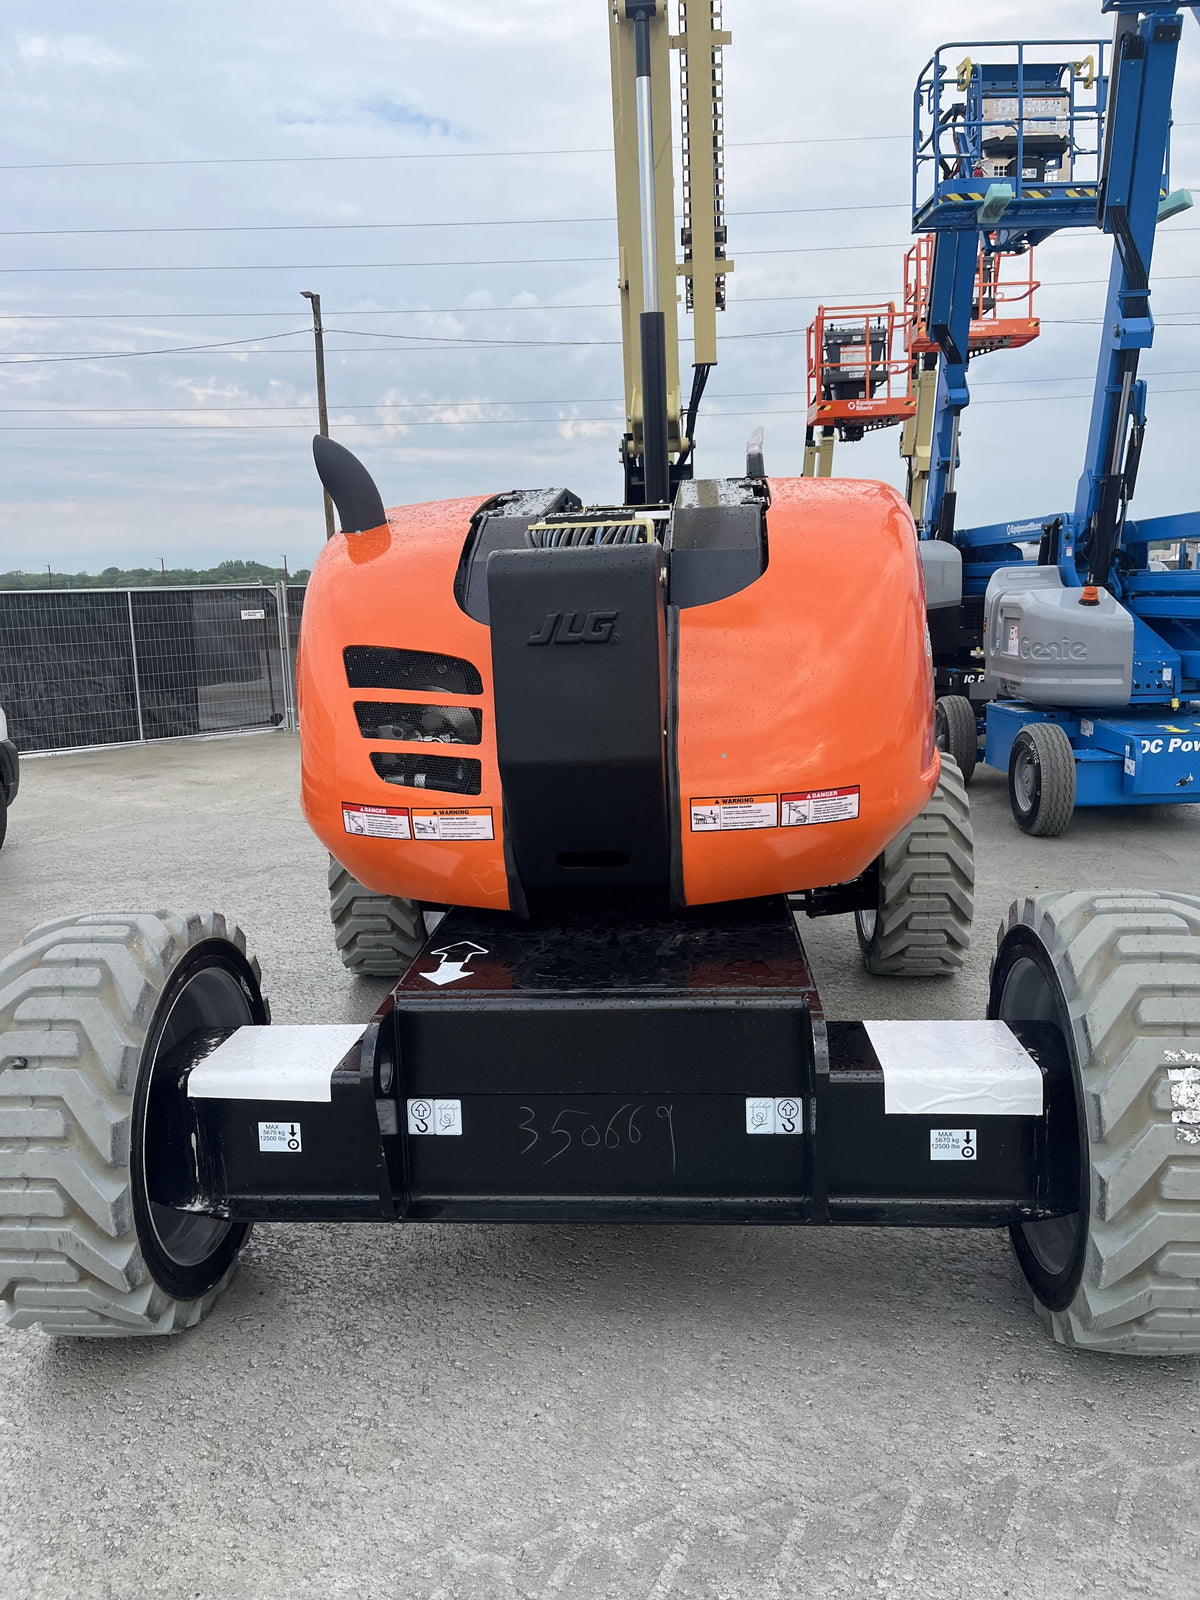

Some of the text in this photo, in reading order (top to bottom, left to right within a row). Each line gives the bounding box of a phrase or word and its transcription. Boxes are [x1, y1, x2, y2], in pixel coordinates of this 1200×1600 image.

[527, 611, 619, 646] JLG
[1020, 636, 1087, 660] Genie
[963, 674, 976, 684] IC
[812, 790, 838, 799] DANGER
[364, 806, 387, 815] DANGER
[519, 1103, 676, 1174] 350669
